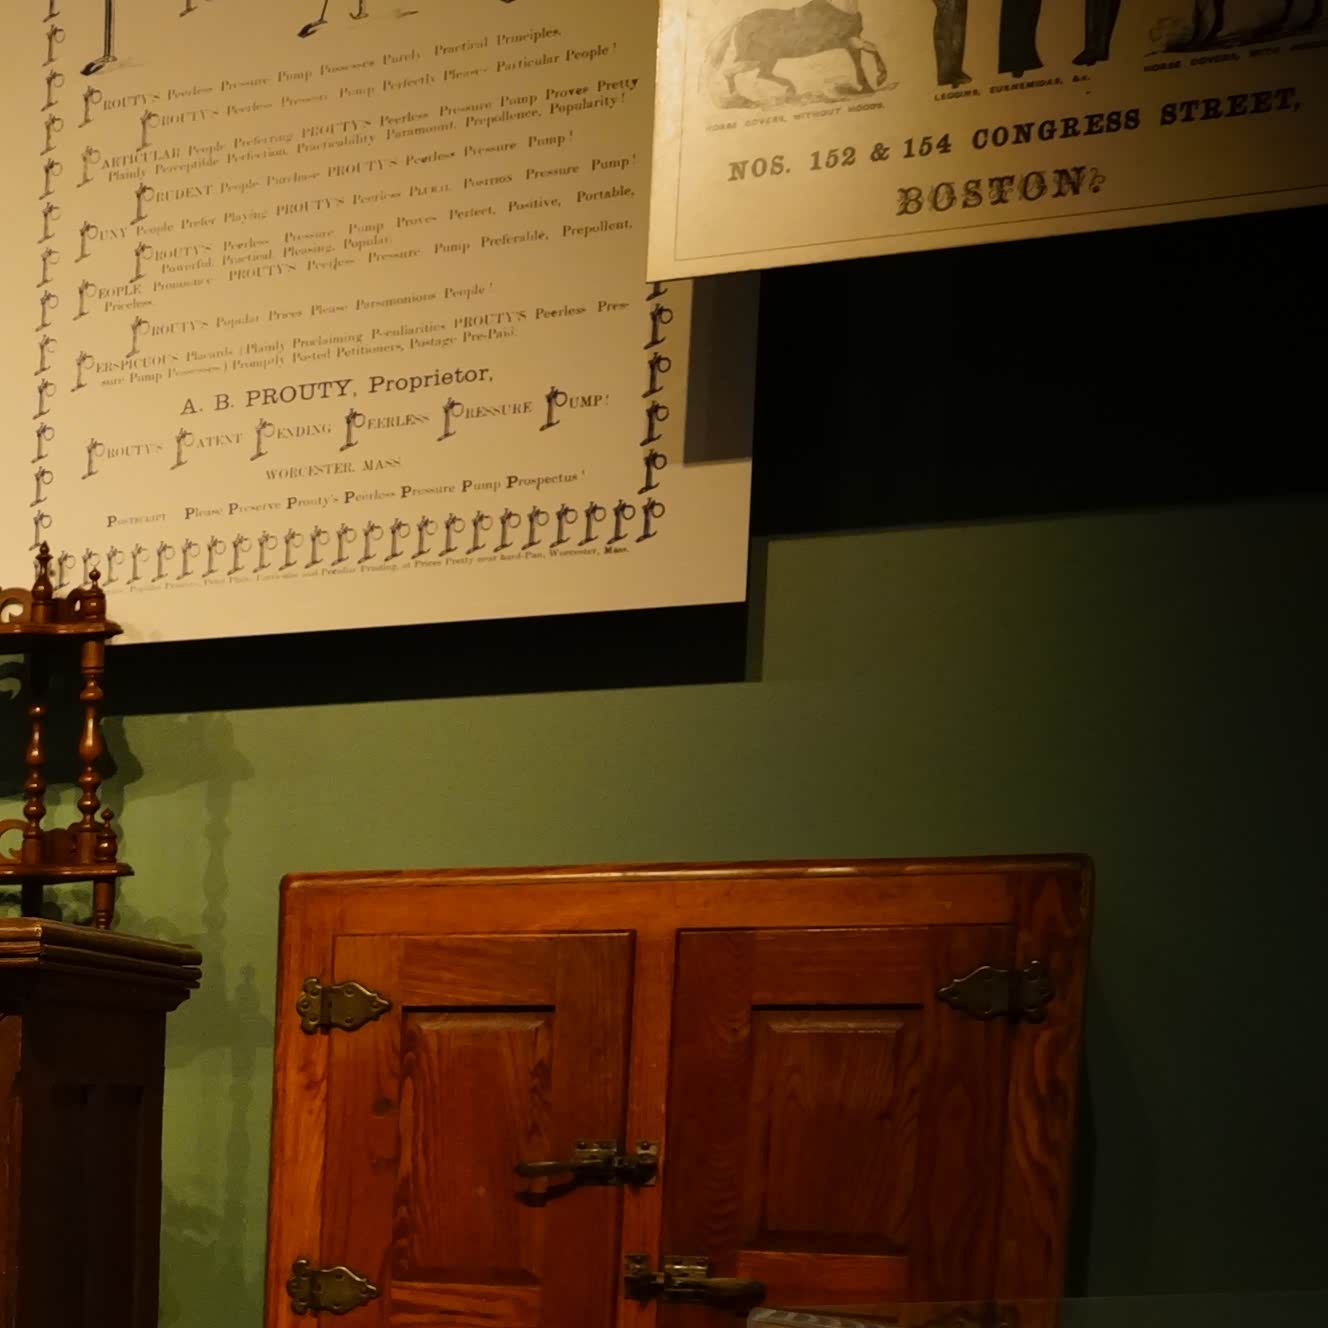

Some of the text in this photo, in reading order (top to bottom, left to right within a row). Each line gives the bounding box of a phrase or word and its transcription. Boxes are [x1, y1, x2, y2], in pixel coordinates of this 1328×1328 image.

[597, 78, 639, 95] Pretty
[727, 87, 1301, 182] NOS. 152 & 154 CONGRESS STREET,
[179, 367, 493, 416] A. B. PROUTY, Proprietor,
